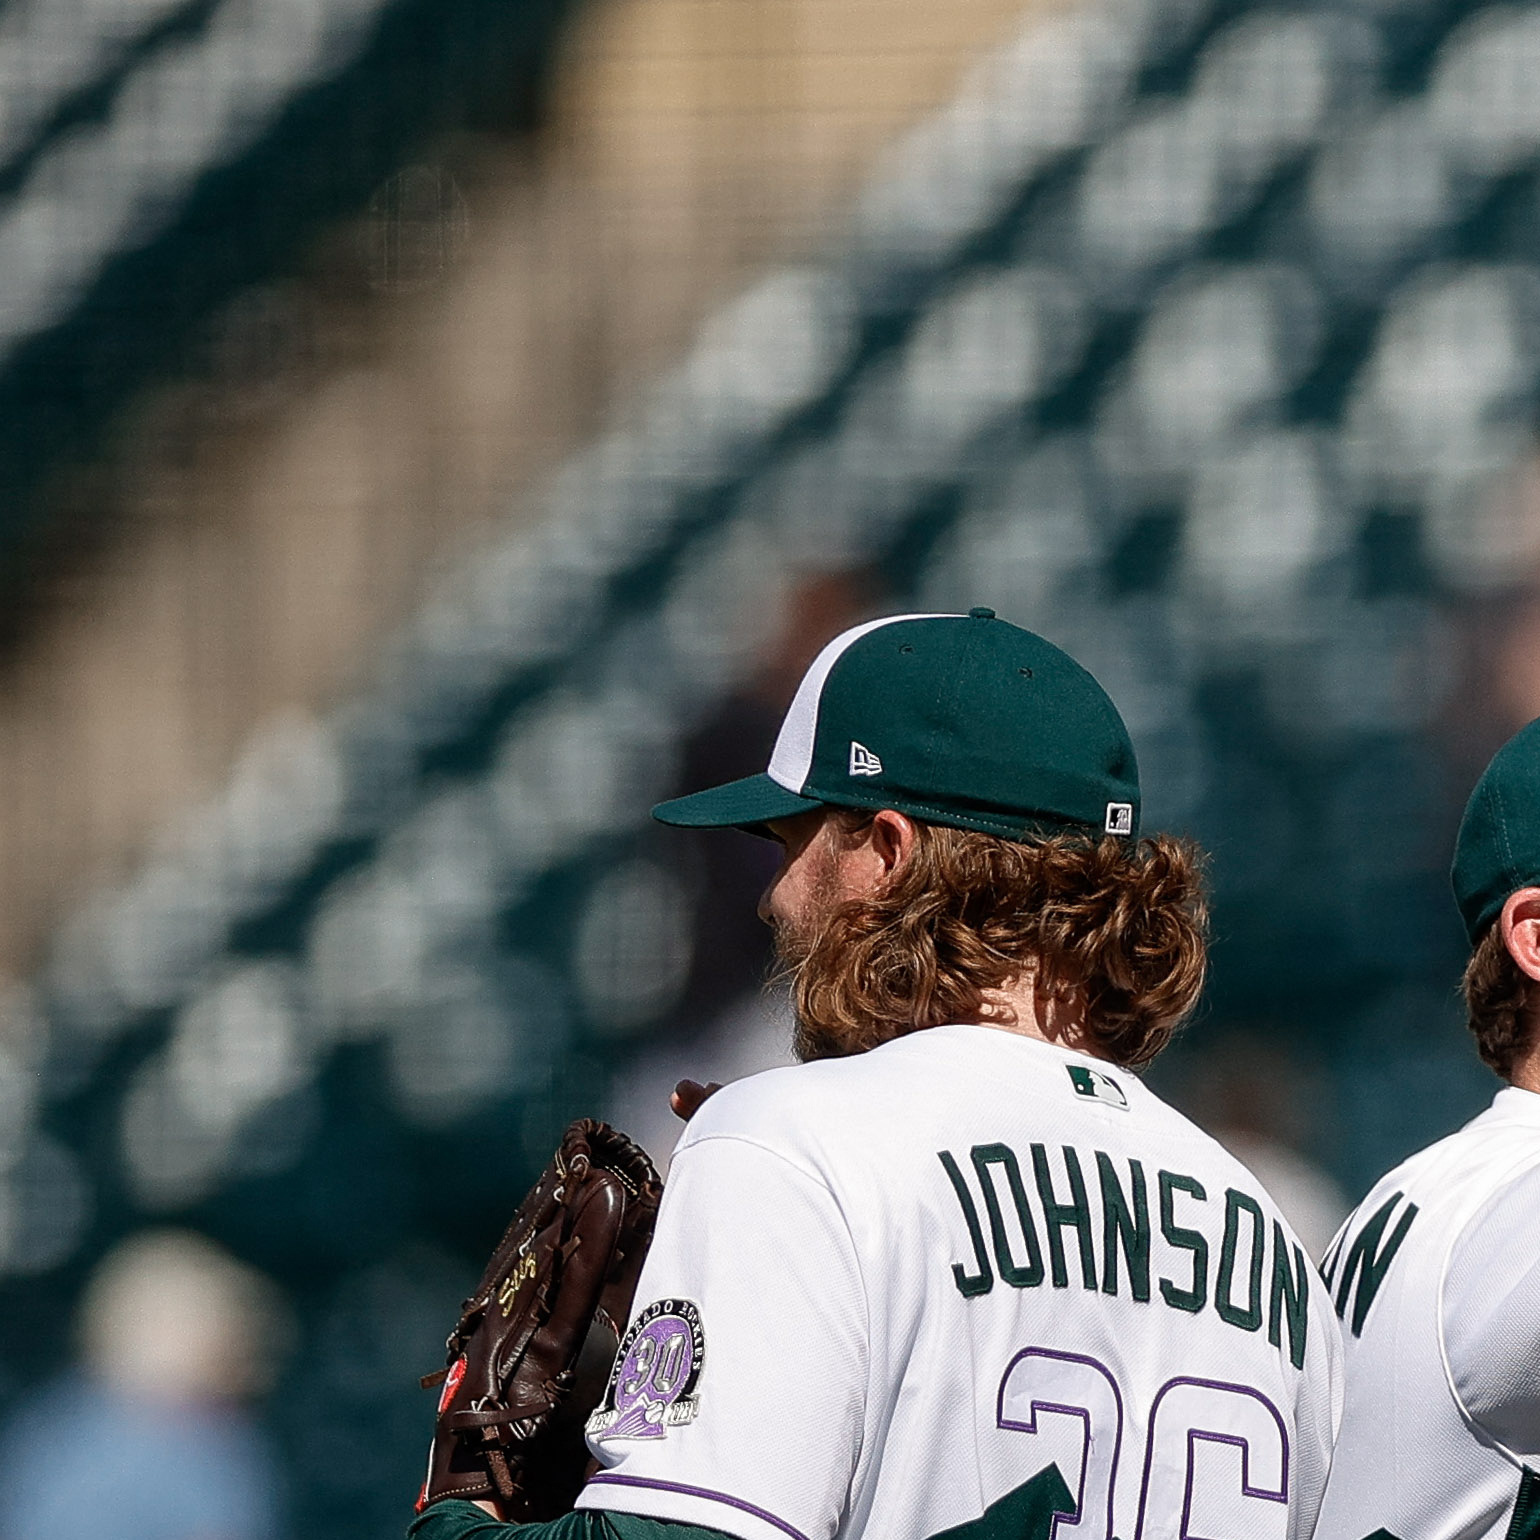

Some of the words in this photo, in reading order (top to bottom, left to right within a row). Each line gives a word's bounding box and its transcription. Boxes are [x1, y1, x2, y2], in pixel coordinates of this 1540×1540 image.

[938, 1142, 1309, 1370] JOHNSON
[611, 1300, 674, 1386] COLORADO
[678, 1301, 704, 1371] ROCKIES
[623, 1333, 687, 1394] 30
